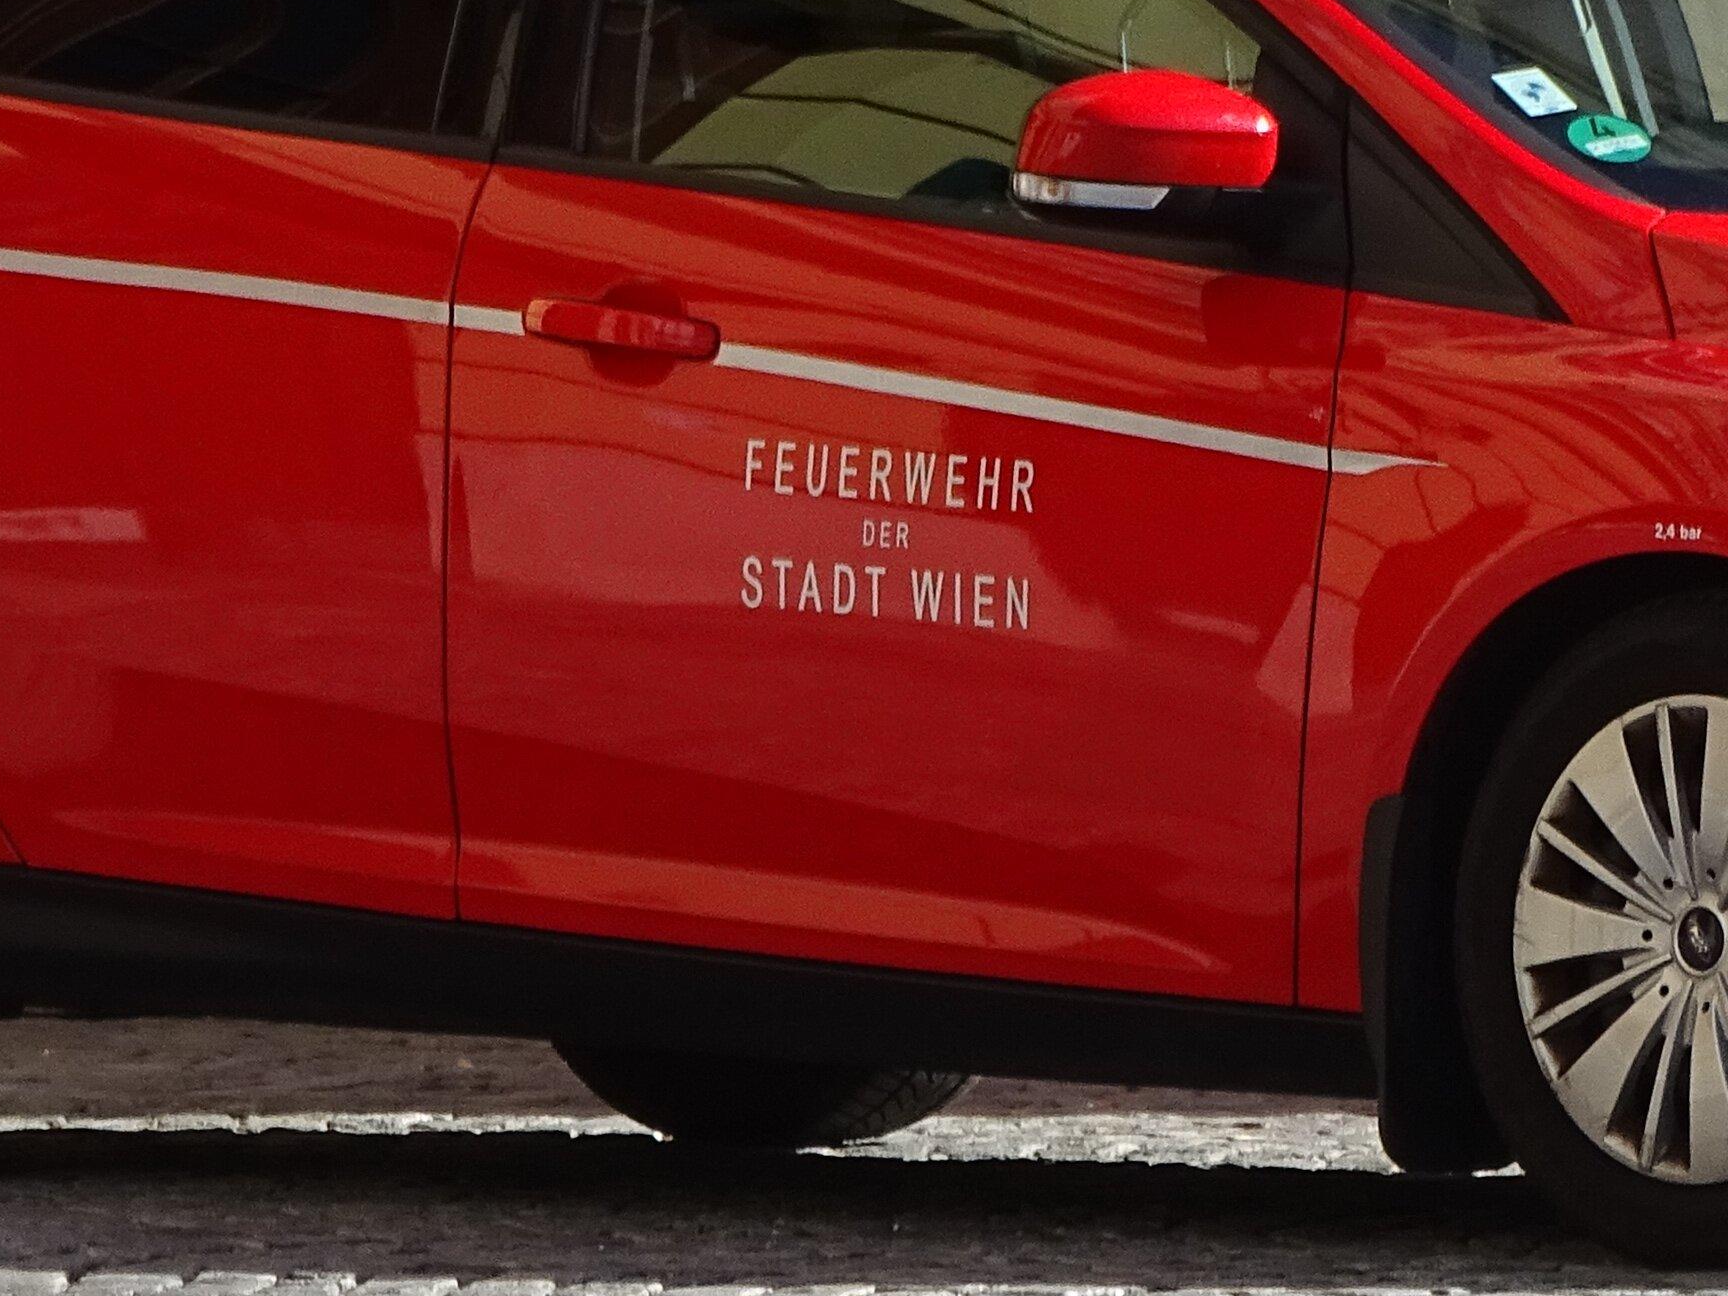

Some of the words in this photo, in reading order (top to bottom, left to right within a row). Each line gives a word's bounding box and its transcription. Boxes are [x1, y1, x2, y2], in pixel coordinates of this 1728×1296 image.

[744, 437, 1035, 514] FEUERWEHR
[862, 518, 910, 550] DER
[1679, 524, 1702, 541] bar
[740, 554, 887, 618] STADT
[910, 568, 1030, 631] WIEN
